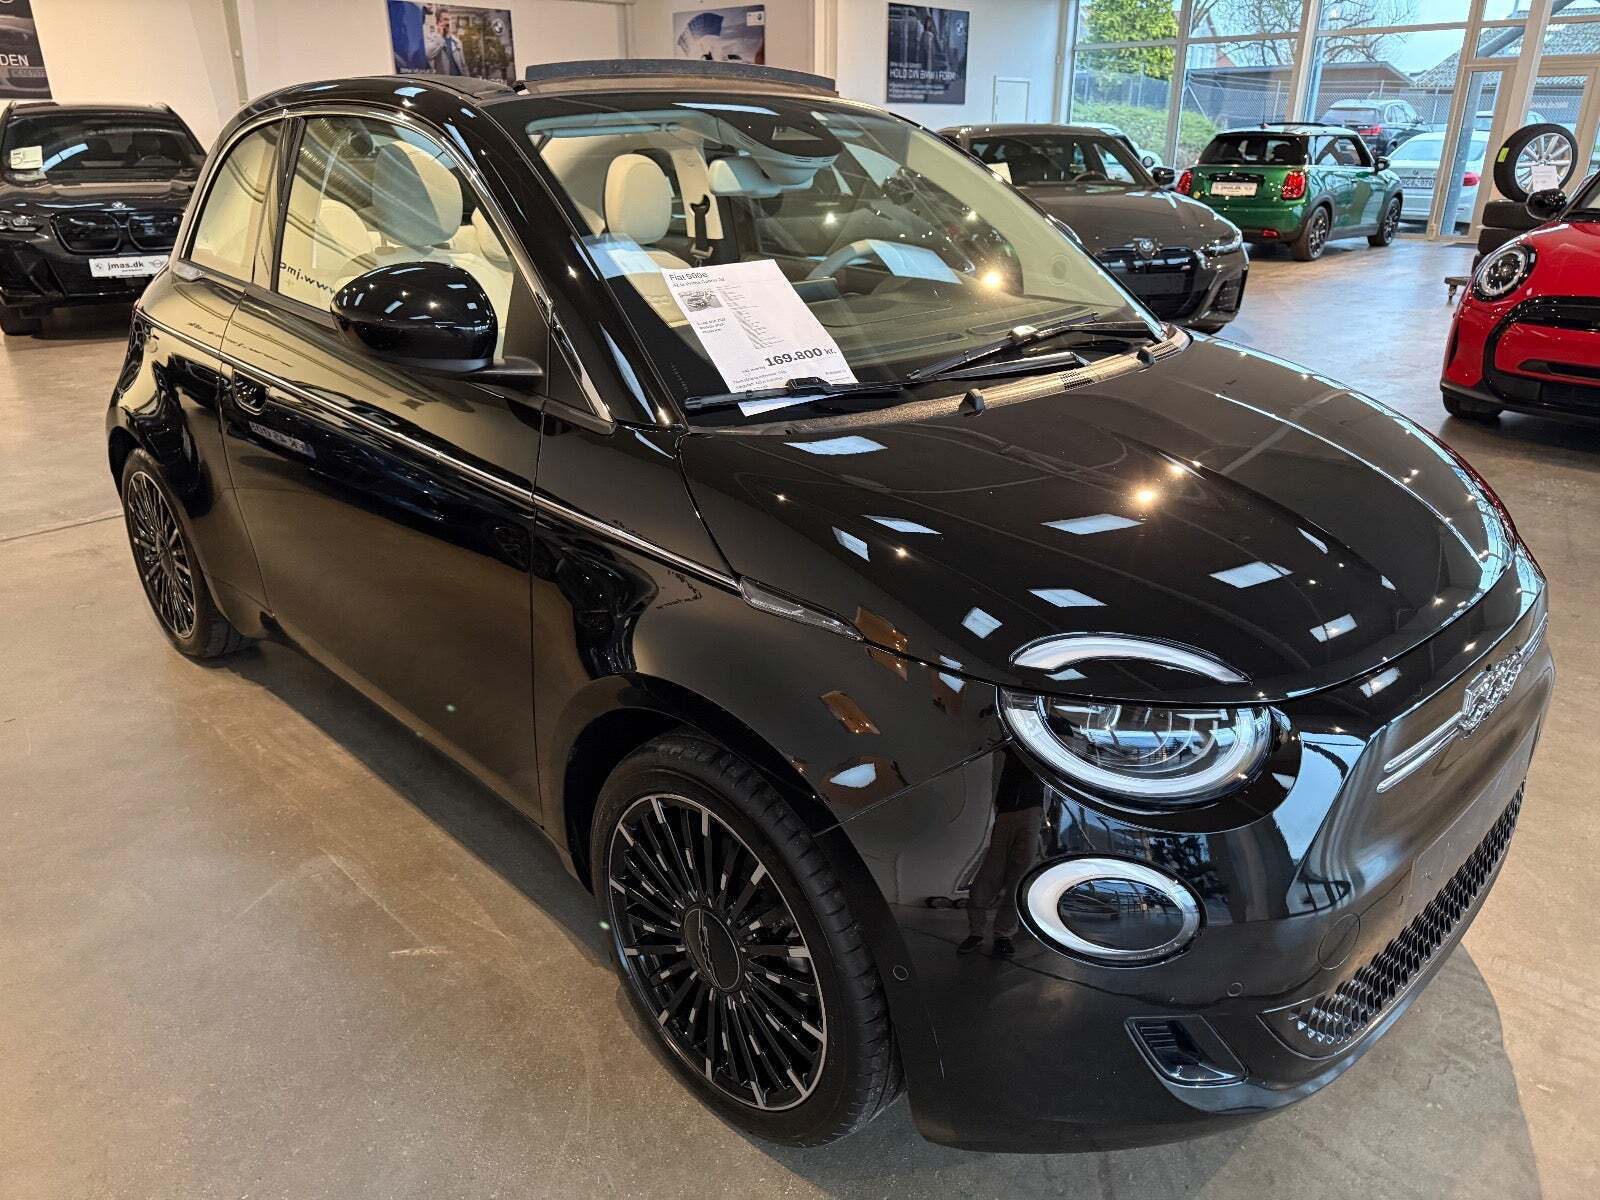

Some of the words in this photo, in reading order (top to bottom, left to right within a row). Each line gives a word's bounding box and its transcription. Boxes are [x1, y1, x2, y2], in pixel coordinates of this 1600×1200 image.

[108, 261, 144, 270] jmas.dk
[669, 273, 686, 281] Fiat
[765, 348, 823, 367] 169.800
